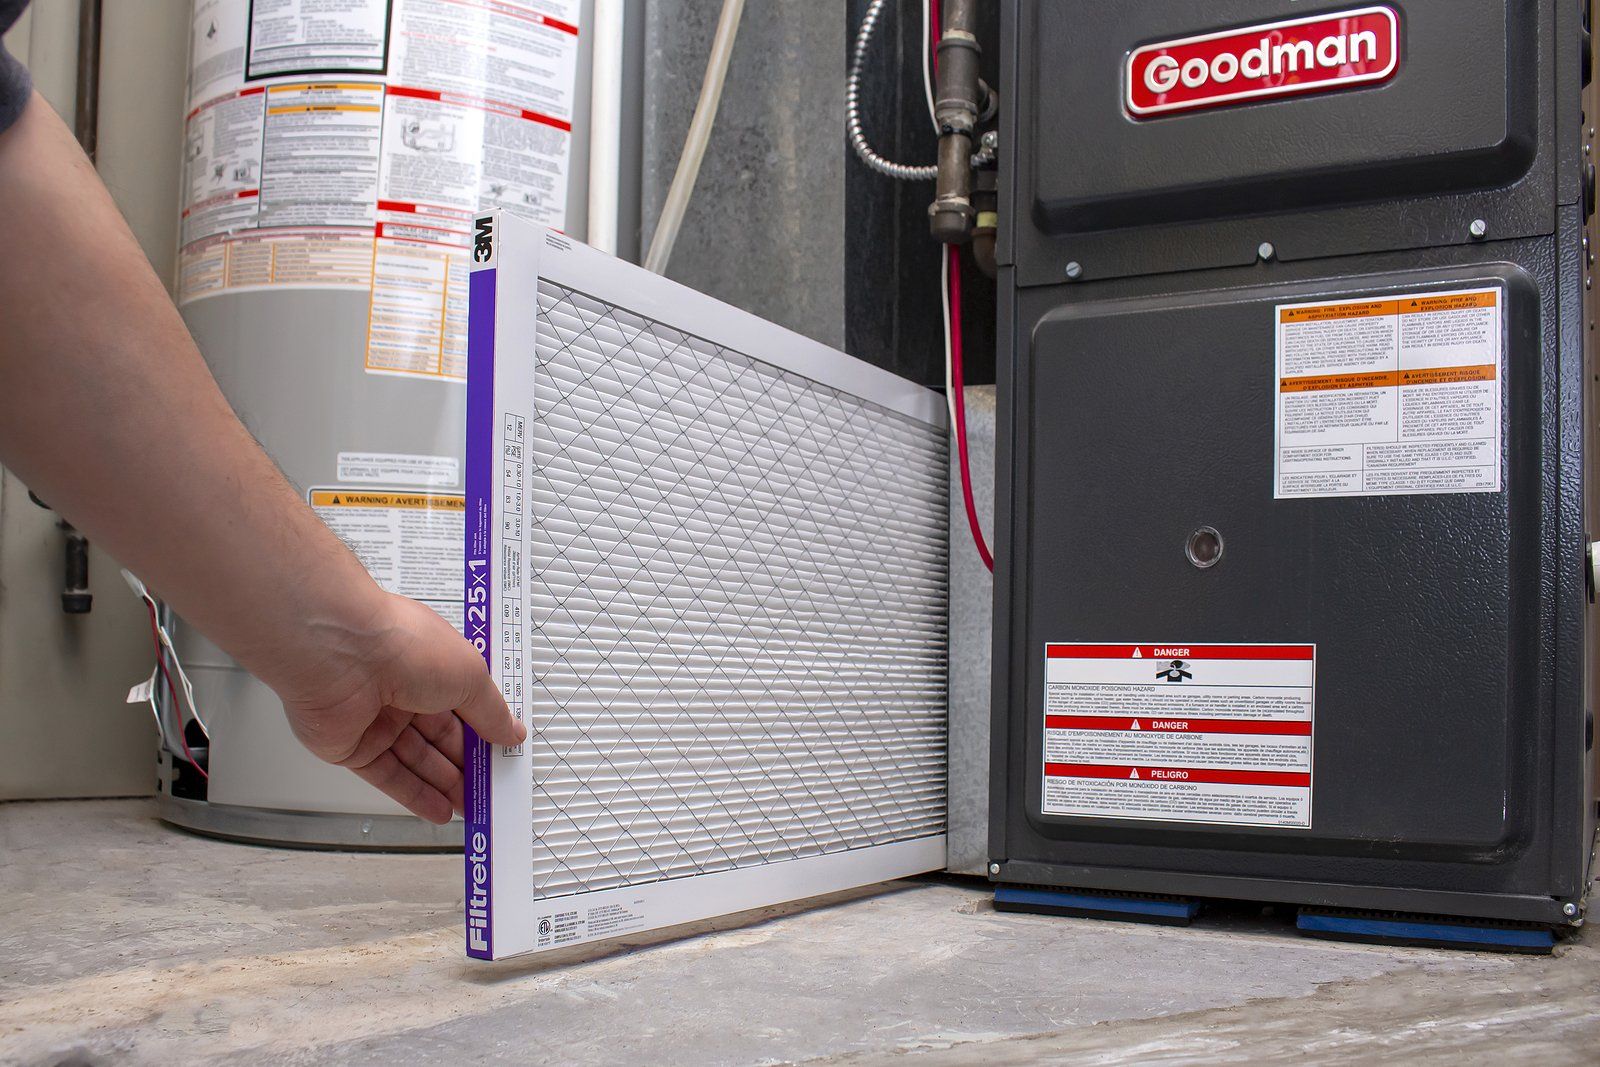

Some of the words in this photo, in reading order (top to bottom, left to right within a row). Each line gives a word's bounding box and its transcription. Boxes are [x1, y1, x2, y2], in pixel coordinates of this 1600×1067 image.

[1143, 30, 1377, 93] Goodman
[474, 216, 493, 263] 3M
[505, 469, 511, 478] 54
[345, 495, 388, 504] WARNING
[395, 497, 465, 508] AVERTISSEMEN
[505, 495, 511, 504] 83
[504, 521, 511, 530] 90
[468, 560, 487, 660] 6x25x1
[1153, 648, 1190, 657] DANGER
[503, 656, 511, 670] 0.22
[514, 682, 522, 697] 1025
[1152, 721, 1188, 730] DANGER
[1068, 730, 1122, 738] D'EMPOISONNEMENT
[1151, 770, 1189, 780] PELIGRO
[469, 831, 488, 952] Filtrete
